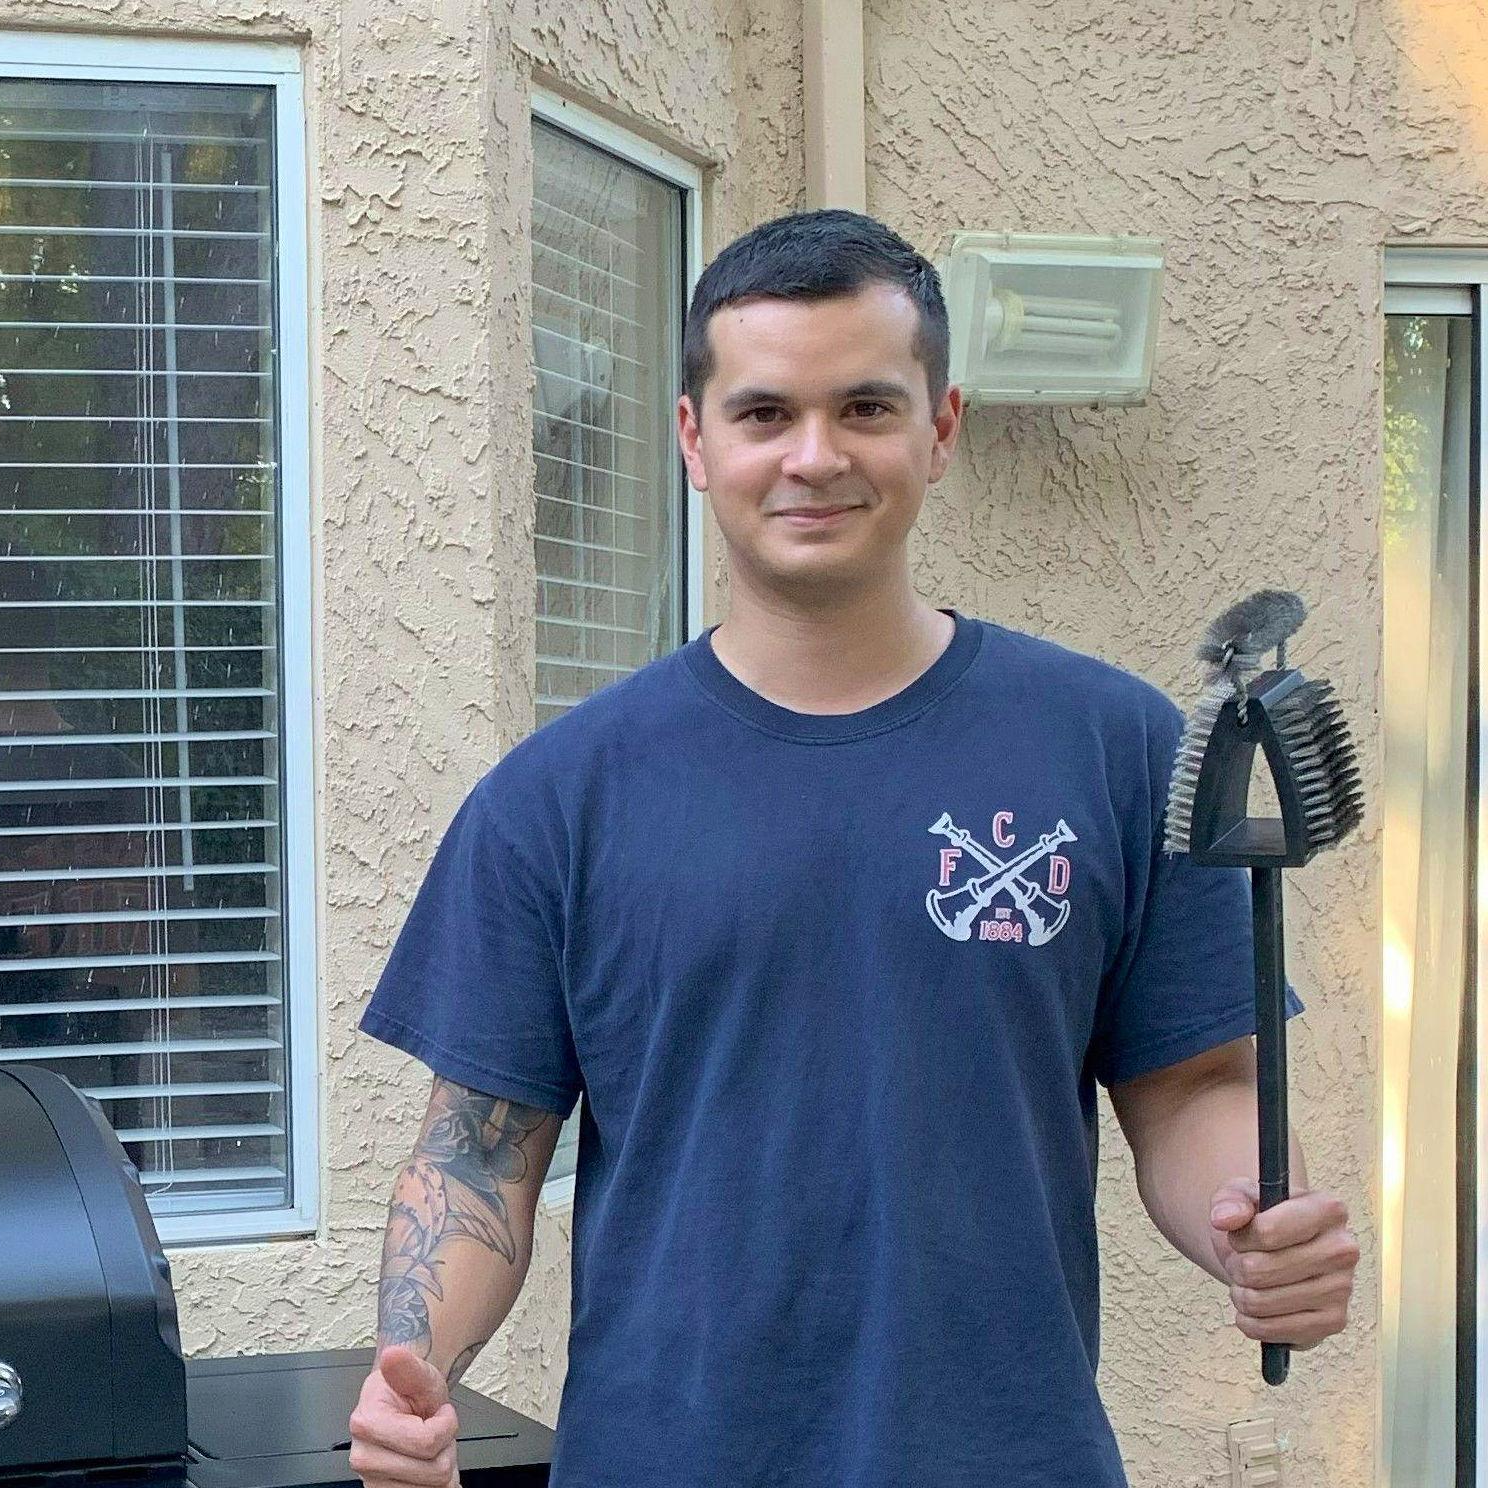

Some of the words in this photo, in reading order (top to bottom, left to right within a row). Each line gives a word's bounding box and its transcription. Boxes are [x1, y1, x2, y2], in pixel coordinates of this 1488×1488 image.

[992, 811, 1015, 848] C
[939, 848, 962, 886] F
[1047, 855, 1071, 895] D
[979, 920, 1023, 943] 1884
